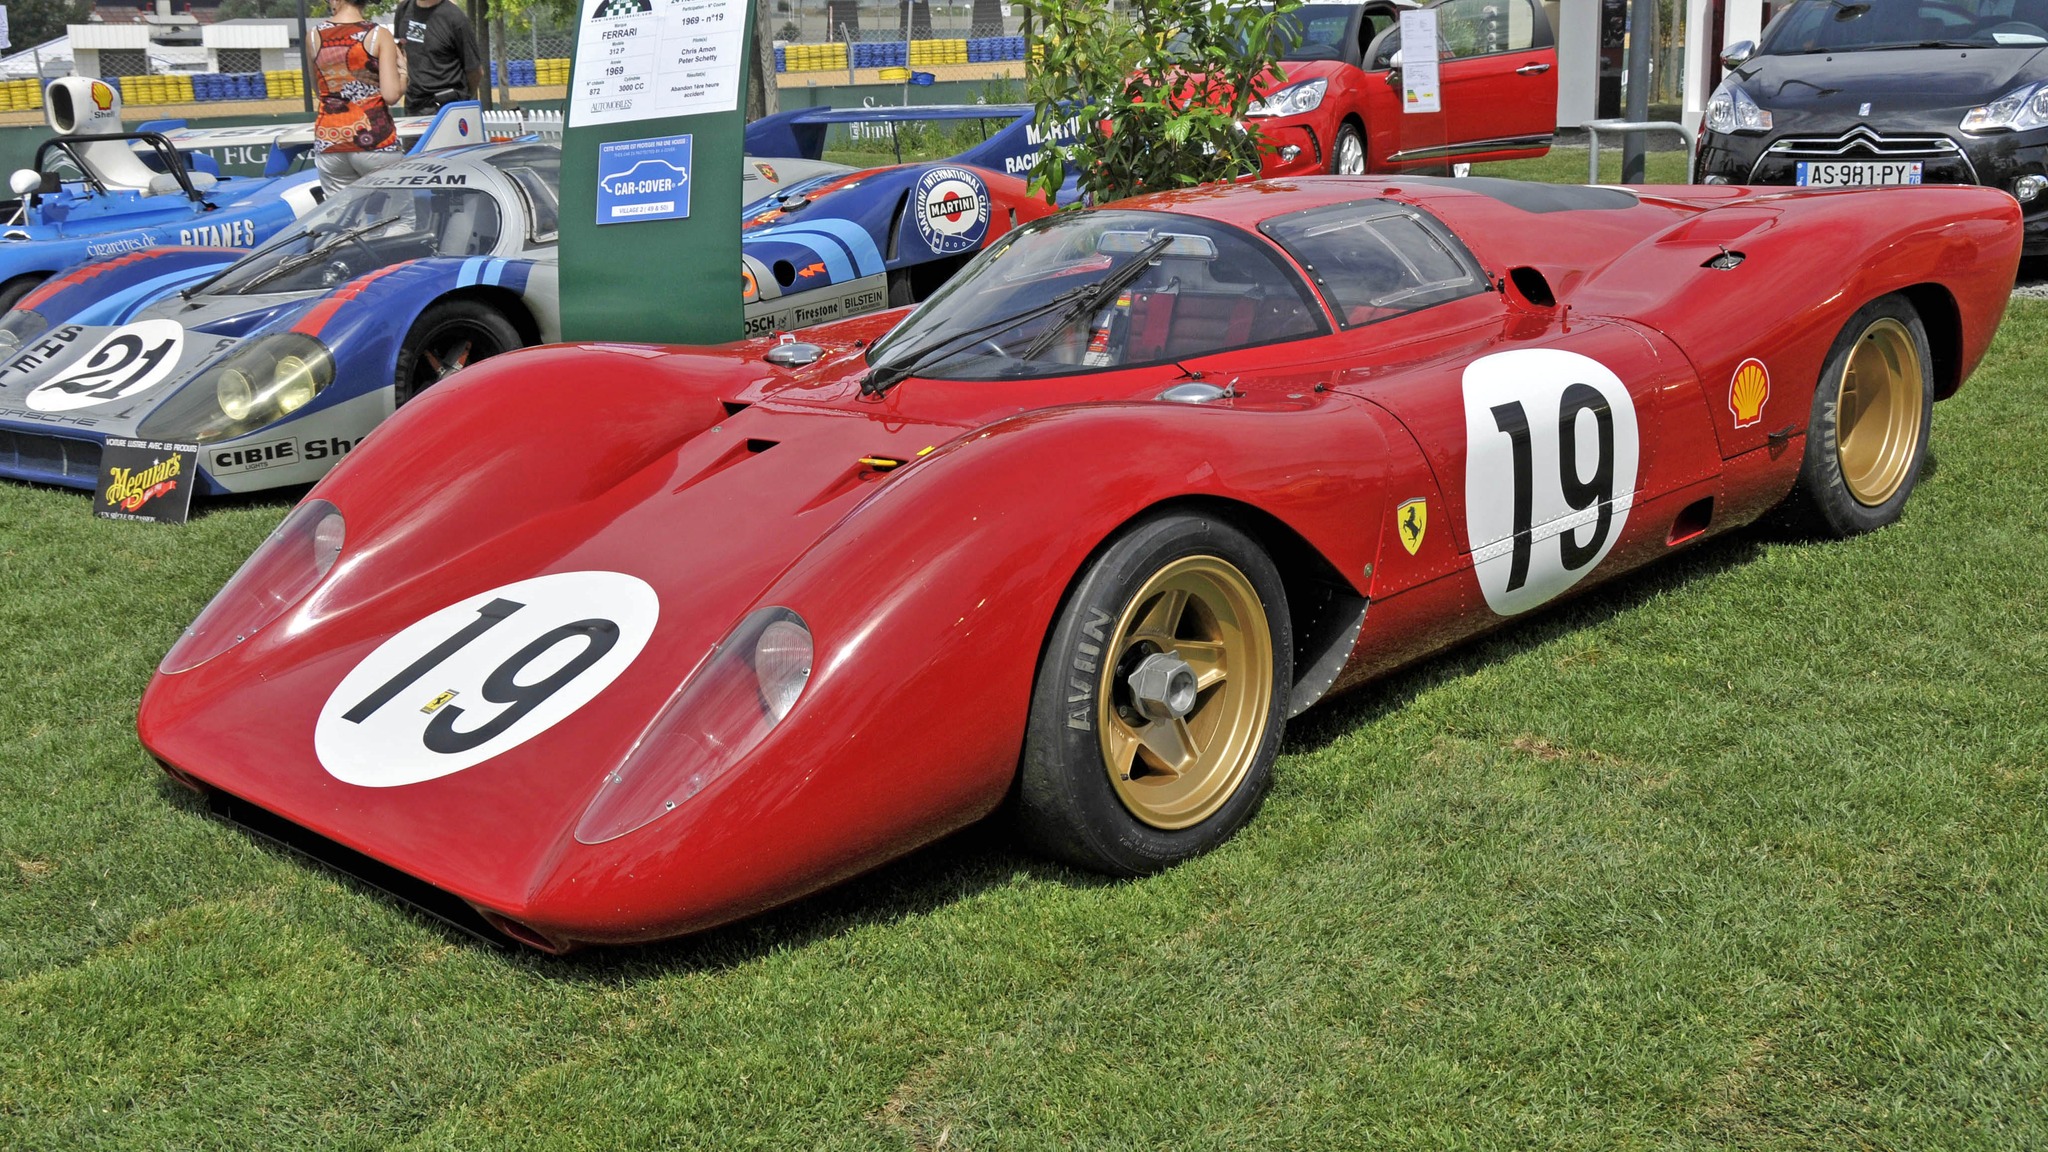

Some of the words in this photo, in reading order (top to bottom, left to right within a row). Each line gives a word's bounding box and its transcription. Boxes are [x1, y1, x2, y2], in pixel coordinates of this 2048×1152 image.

[682, 16, 700, 26] 1969
[706, 13, 724, 22] n°19
[602, 28, 638, 40] FERRARI
[605, 66, 624, 76] 1969
[94, 111, 115, 119] Shell
[591, 99, 632, 113] AUTOMOBILES
[923, 169, 979, 193] INTERNATIONAL
[918, 187, 931, 237] MARTINI
[930, 196, 974, 217] MARTINI
[978, 195, 987, 223] CLUB
[180, 219, 256, 248] GITANES
[845, 291, 882, 309] BILSTEIN
[795, 303, 838, 323] Firestone
[745, 316, 775, 335] OSCH
[38, 334, 176, 400] 21
[173, 443, 197, 452] PRODUITS
[304, 437, 364, 460] Sh
[245, 461, 269, 470] LIGHTS
[106, 452, 181, 508] Meguiar's
[1490, 383, 1614, 593] 19
[341, 597, 621, 754] 19
[1066, 607, 1112, 731] AVON
